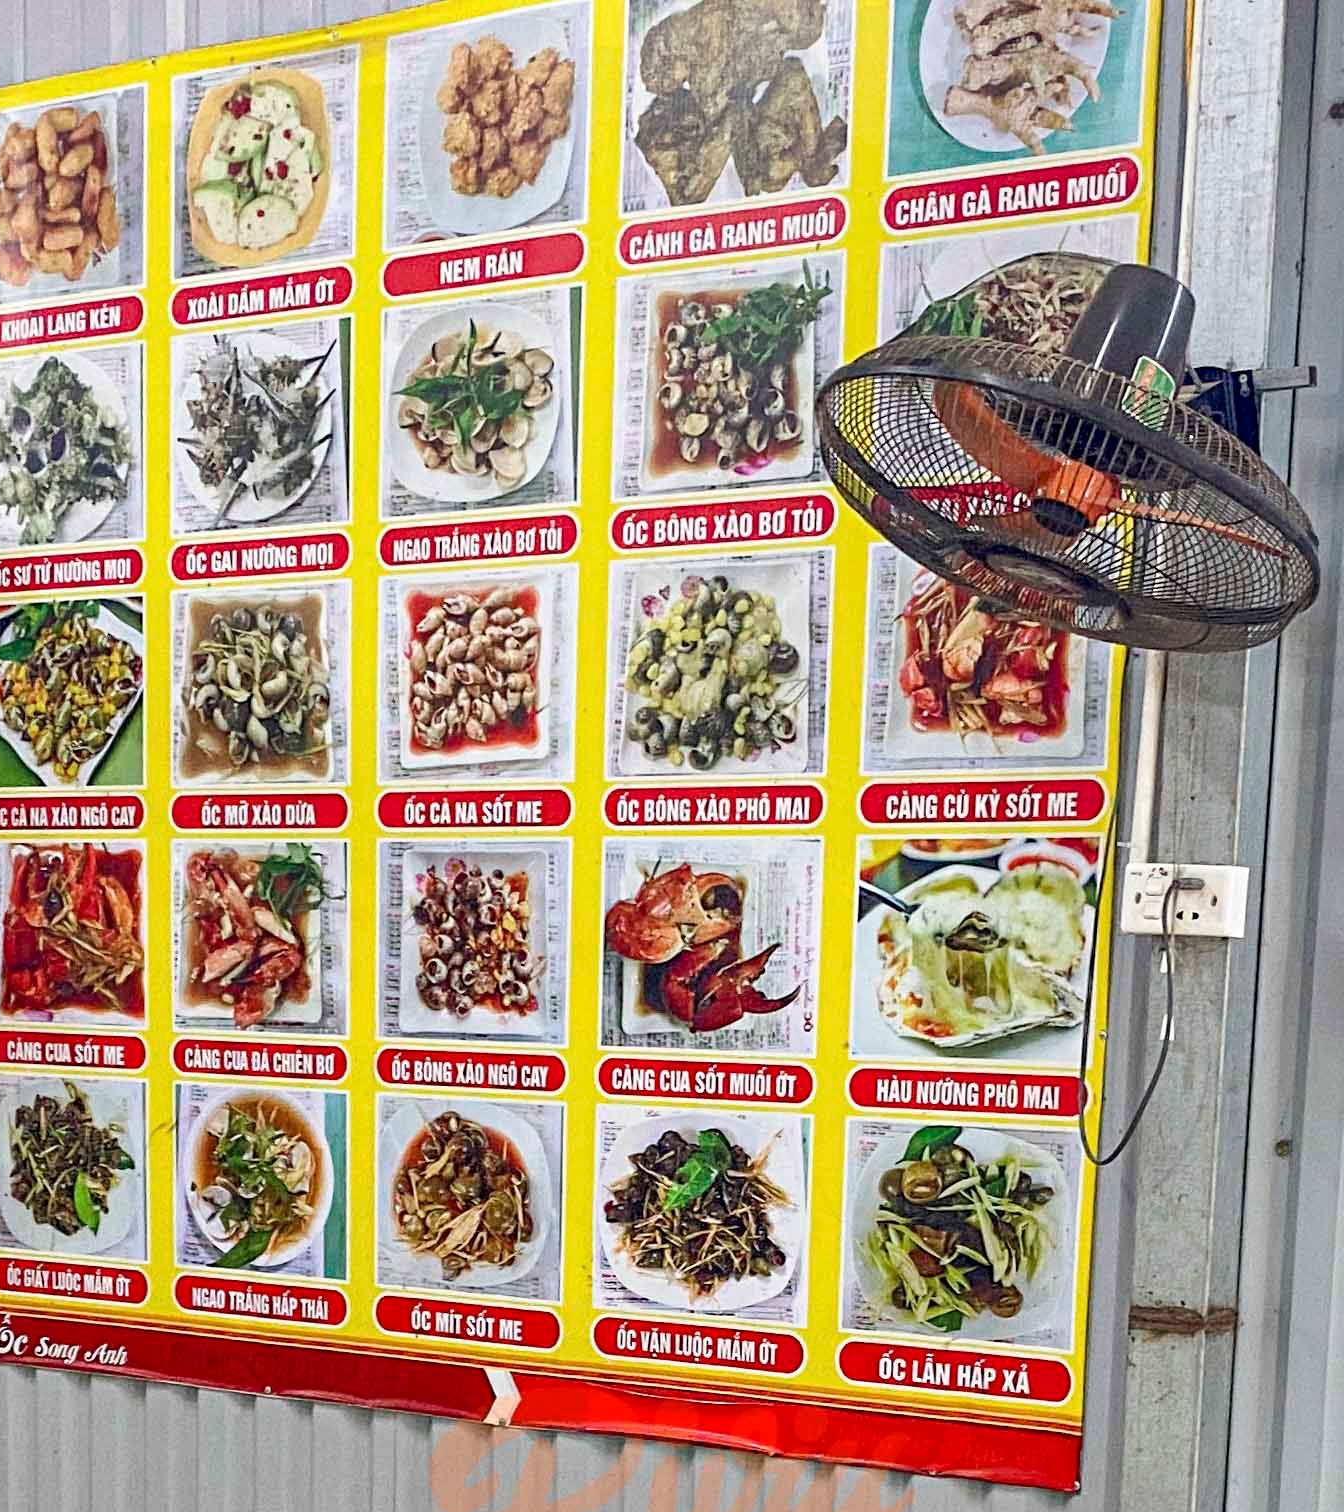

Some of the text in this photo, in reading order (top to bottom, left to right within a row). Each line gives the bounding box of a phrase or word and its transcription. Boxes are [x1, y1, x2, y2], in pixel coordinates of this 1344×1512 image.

[895, 166, 1126, 225] CHÂN GÀ RANG MUỐI
[630, 207, 834, 260] CÁNH GÀ RANG MUỐI
[440, 256, 480, 283] NEM
[1, 316, 43, 341] KHOAI
[47, 310, 85, 335] LANG
[622, 499, 822, 545] ỐC BÔNG XÀO BƠ TỎI
[393, 519, 561, 561] NGAO TRẮNG XÀO BƠ TỎI
[201, 798, 220, 825] ỐC
[252, 800, 281, 825] XÀO
[285, 800, 315, 825] DỪA
[404, 794, 541, 823] ỐC CÀ NA SỐT ME
[617, 792, 809, 822] ỐC BÔNG XÀO PHÔ MAI
[886, 790, 937, 819] CÀNG
[1005, 785, 1042, 817] SỐT
[1047, 792, 1077, 816] ME
[7, 1037, 124, 1065] CÀNG CUA SỐT ME
[612, 1064, 654, 1090] CÀNG
[660, 1070, 690, 1092] CUA
[695, 1064, 724, 1094] SỐT
[730, 1066, 770, 1096] MUỐI
[877, 1074, 912, 1102] HÀU
[984, 1078, 1018, 1107] PHÔ
[1023, 1085, 1059, 1109] MAI
[192, 1285, 327, 1319] NGAO TRẮNG HẤP THÁI
[411, 1302, 522, 1341] ỐC MÍT SỐT ME
[34, 1336, 80, 1364] Song
[83, 1344, 128, 1366] Anh
[617, 1321, 636, 1350] ỐC
[640, 1327, 670, 1358] VẶN
[675, 1330, 712, 1362] LUỘC
[879, 1349, 906, 1381] ỐC
[957, 1357, 995, 1389] HẤP
[1002, 1362, 1029, 1393] XẢ
